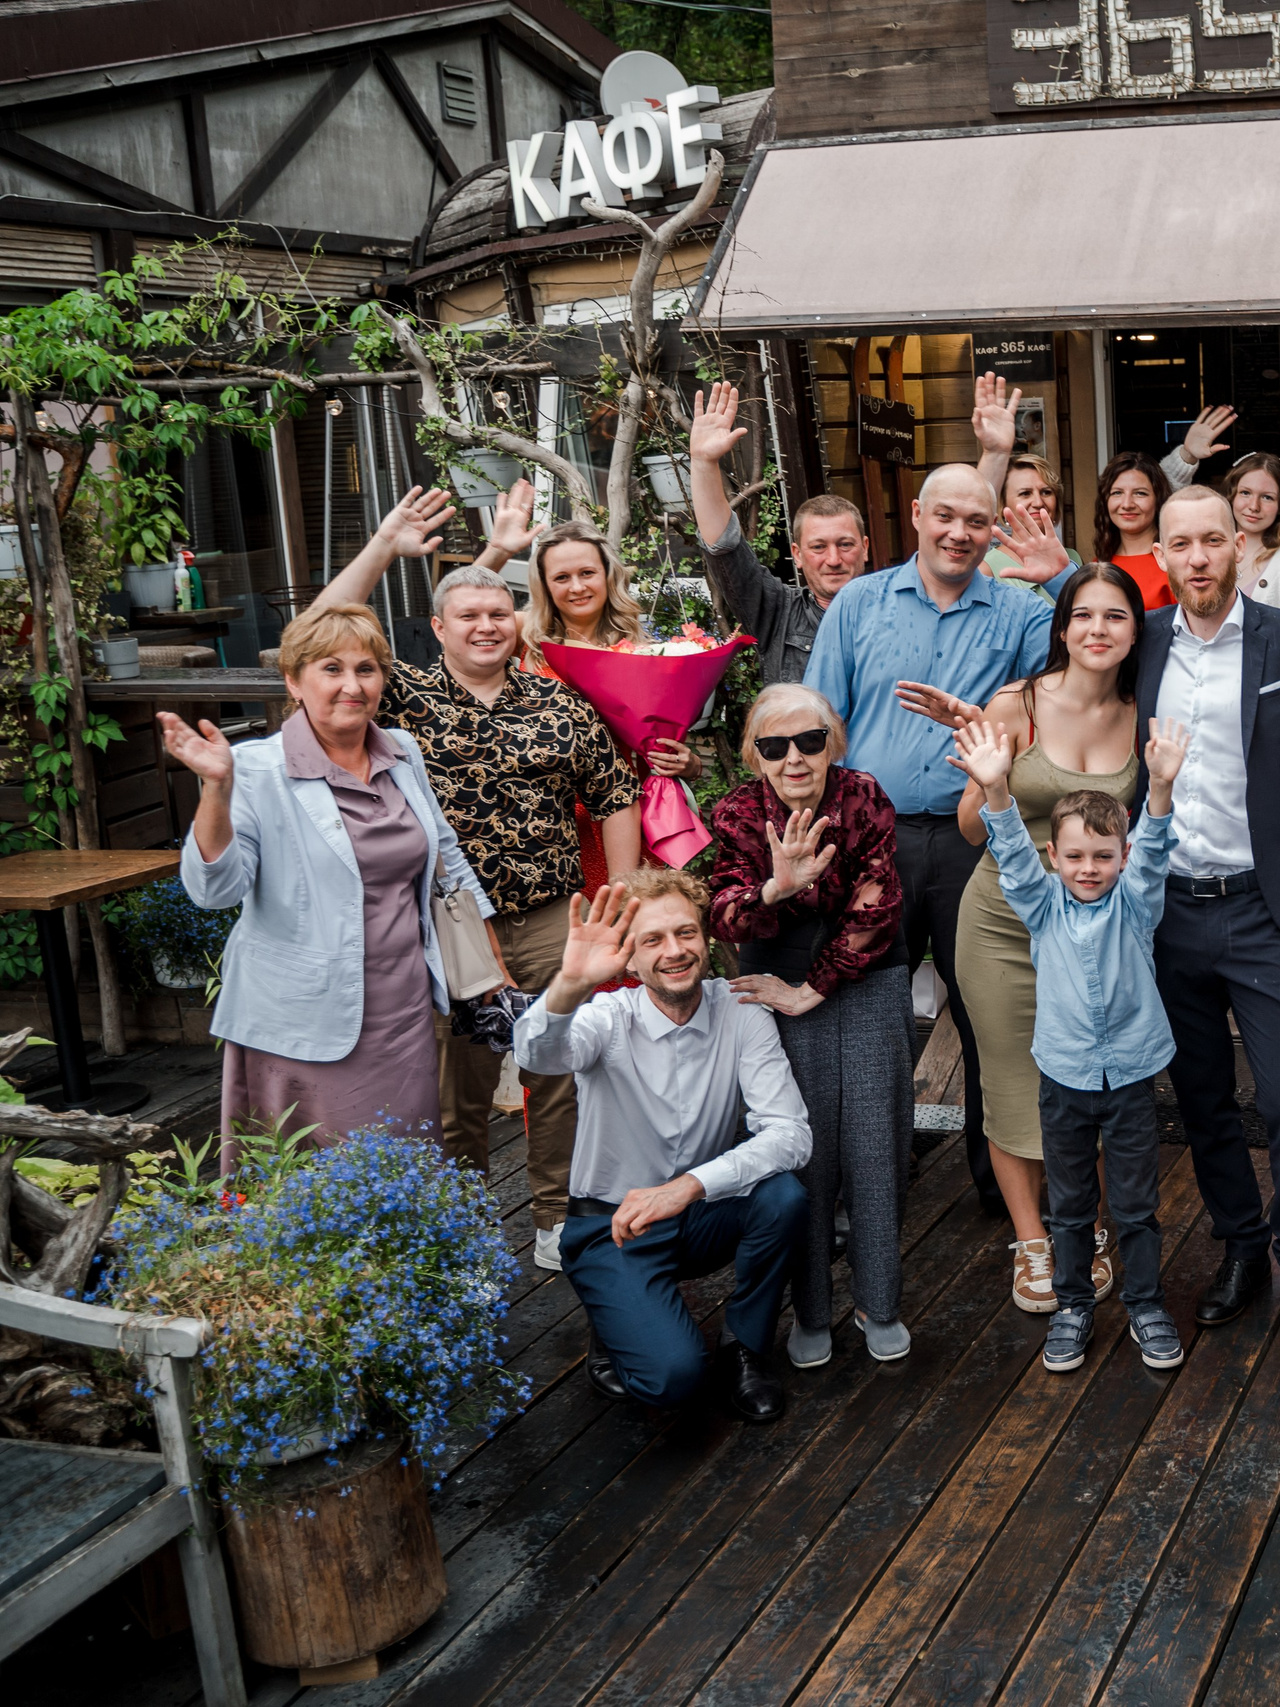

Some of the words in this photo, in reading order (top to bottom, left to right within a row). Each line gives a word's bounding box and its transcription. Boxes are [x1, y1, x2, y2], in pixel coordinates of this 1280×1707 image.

[507, 85, 723, 229] КАФЕ
[975, 346, 998, 354] КАФЕ
[1001, 340, 1025, 353] 365
[1027, 344, 1051, 352] КАФЕ
